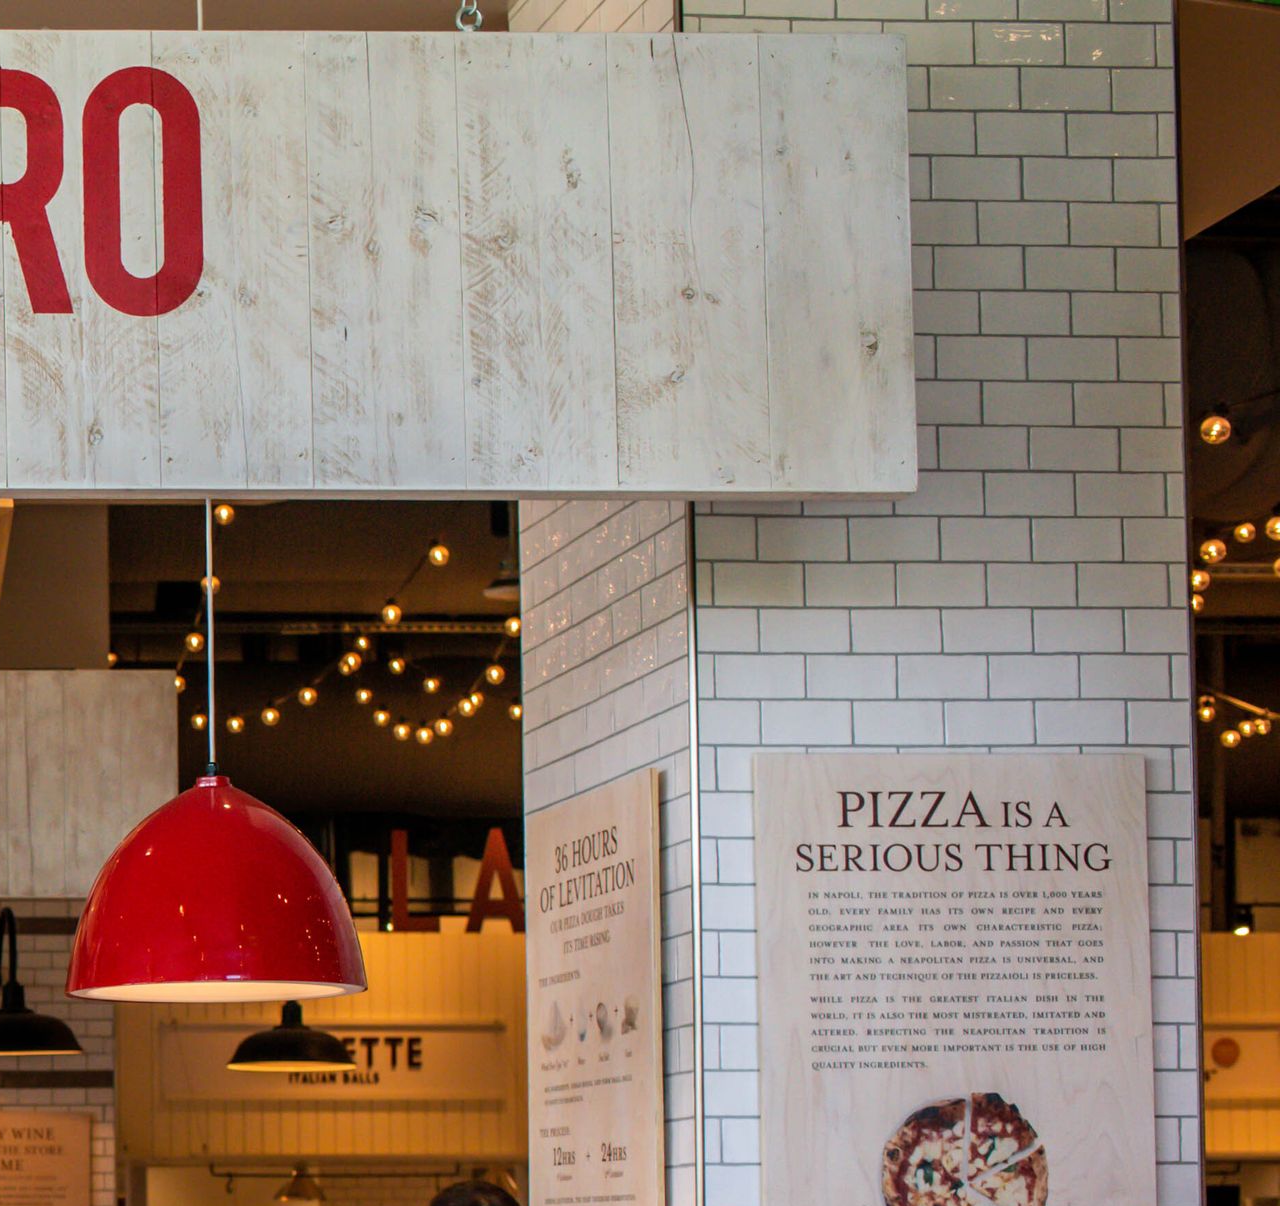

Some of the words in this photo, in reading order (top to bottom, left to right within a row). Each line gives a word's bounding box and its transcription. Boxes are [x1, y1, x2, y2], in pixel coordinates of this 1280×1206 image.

[837, 790, 992, 828] PIZZA
[1001, 800, 1033, 828] IS
[1042, 801, 1070, 828] A
[555, 843, 568, 874] 36
[572, 826, 618, 868] HOURS
[795, 842, 963, 872] SERIOUS
[974, 842, 1112, 872] THING
[540, 885, 555, 913] OF
[559, 858, 635, 908] LEVITATION
[807, 891, 819, 900] IN
[868, 890, 888, 899] THE
[891, 890, 948, 899] TRADITION
[950, 890, 964, 899] OF
[967, 890, 996, 899] PIZZA
[998, 890, 1009, 899] IS
[1011, 890, 1039, 899] OVER
[1041, 890, 1068, 900] 1,000
[1070, 890, 1103, 899] YEARS
[839, 907, 871, 916] EVERY
[877, 907, 913, 916] FAMILY
[920, 907, 941, 916] HAS
[947, 906, 964, 915] ITS
[970, 906, 994, 916] OWN
[1001, 906, 1036, 915] RECIPE
[1042, 906, 1065, 915] AND
[1071, 906, 1103, 915] EVERY
[807, 923, 873, 932] GEOGRAPHIC
[882, 923, 909, 932] AREA
[918, 923, 935, 932] ITS
[942, 923, 967, 932] OWN
[975, 922, 1062, 932] CHARACTERISTIC
[808, 939, 858, 949] HOWEVER
[868, 940, 889, 948] THE
[971, 939, 995, 948] AND
[999, 939, 1040, 948] PASSION
[1045, 939, 1073, 948] THAT
[1076, 939, 1104, 948] GOES
[809, 956, 836, 965] INTO
[840, 956, 882, 965] MAKING
[887, 956, 894, 964] A
[899, 955, 963, 965] NEAPOLITAN
[968, 955, 997, 964] PIZZA
[1001, 955, 1012, 964] IS
[1082, 955, 1105, 964] AND
[809, 972, 830, 982] THE
[832, 972, 852, 981] ART
[854, 972, 877, 981] AND
[879, 972, 938, 983] TECHNIQUE
[940, 972, 954, 981] OF
[956, 972, 977, 981] THE
[979, 971, 1029, 981] PIZZAIOLI
[1031, 972, 1042, 980] IS
[809, 995, 843, 1004] WHILE
[849, 994, 878, 1004] PIZZA
[885, 995, 895, 1004] IS
[901, 995, 922, 1003] THE
[928, 994, 979, 1003] GREATEST
[985, 994, 1028, 1003] ITALIAN
[1034, 994, 1059, 1003] DISH
[1065, 994, 1078, 1003] IN
[1084, 994, 1105, 1003] THE
[852, 1011, 862, 1020] IT
[866, 1011, 876, 1020] IS
[879, 1011, 905, 1020] ALSO
[908, 1011, 928, 1020] THE
[931, 1011, 958, 1020] MOST
[1031, 1010, 1081, 1019] IMITATED
[1083, 1010, 1106, 1019] AND
[865, 1027, 927, 1037] RESPECTING
[934, 1027, 954, 1036] THE
[961, 1027, 1026, 1036] NEAPOLITAN
[1032, 1026, 1089, 1036] TRADITION
[1096, 1026, 1107, 1035] IS
[342, 1037, 422, 1070] ETTE
[288, 1072, 337, 1084] ITALIAN
[11, 1127, 56, 1141] WINE
[600, 1141, 628, 1162] 24HRS
